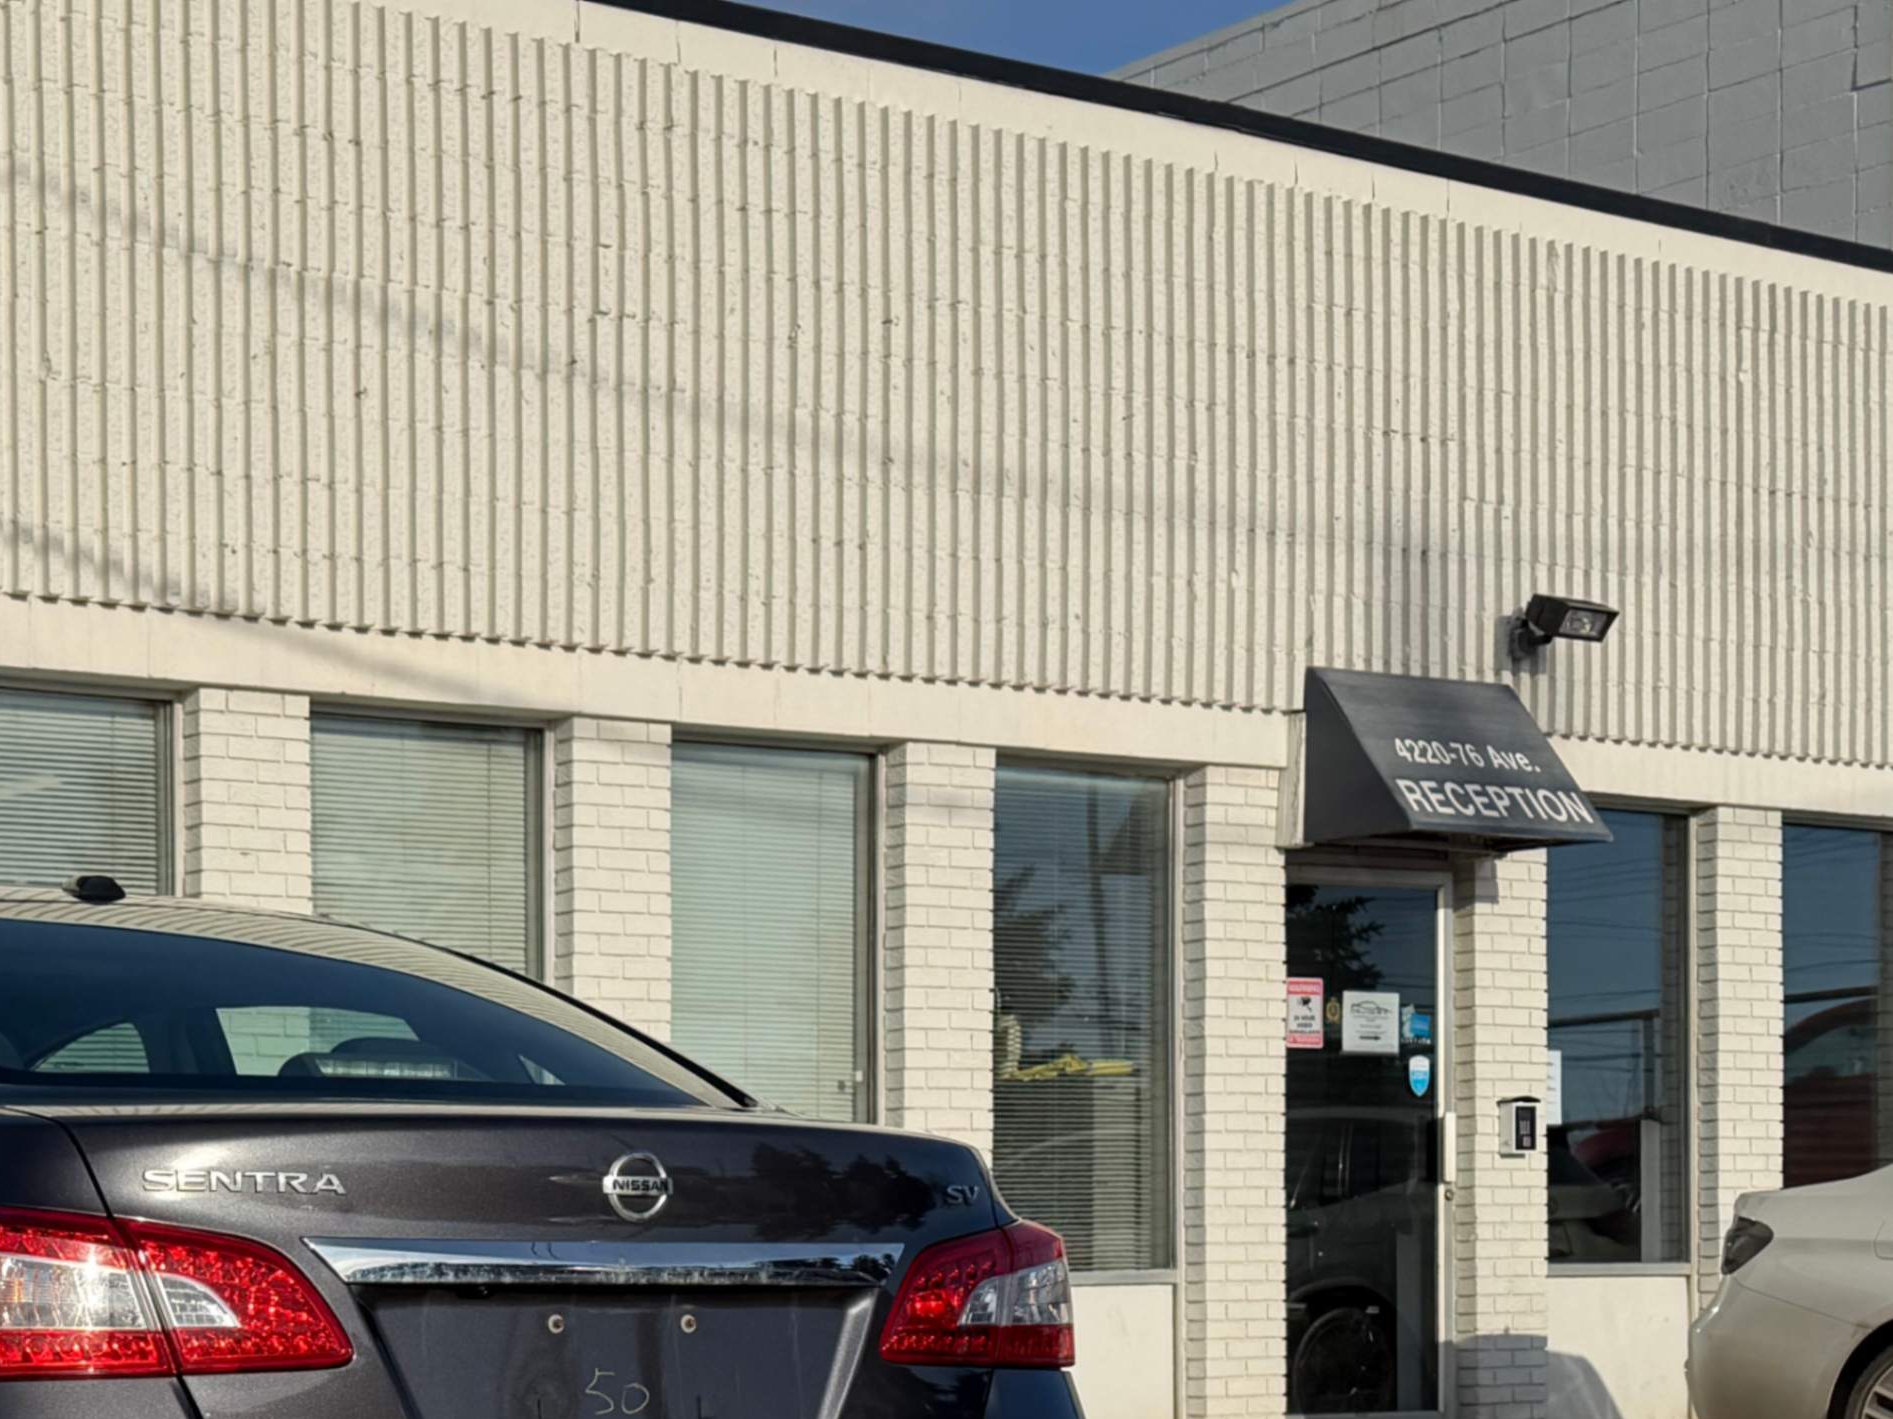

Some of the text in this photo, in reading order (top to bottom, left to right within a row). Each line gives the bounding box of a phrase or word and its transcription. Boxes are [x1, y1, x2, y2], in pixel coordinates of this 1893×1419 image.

[1394, 737, 1542, 773] 4220-76 Ave.
[1395, 778, 1594, 824] RECEPTION
[142, 1169, 346, 1196] SENTRA
[612, 1179, 668, 1192] NISSAN
[946, 1184, 979, 1204] SV
[585, 1367, 650, 1415] 50
